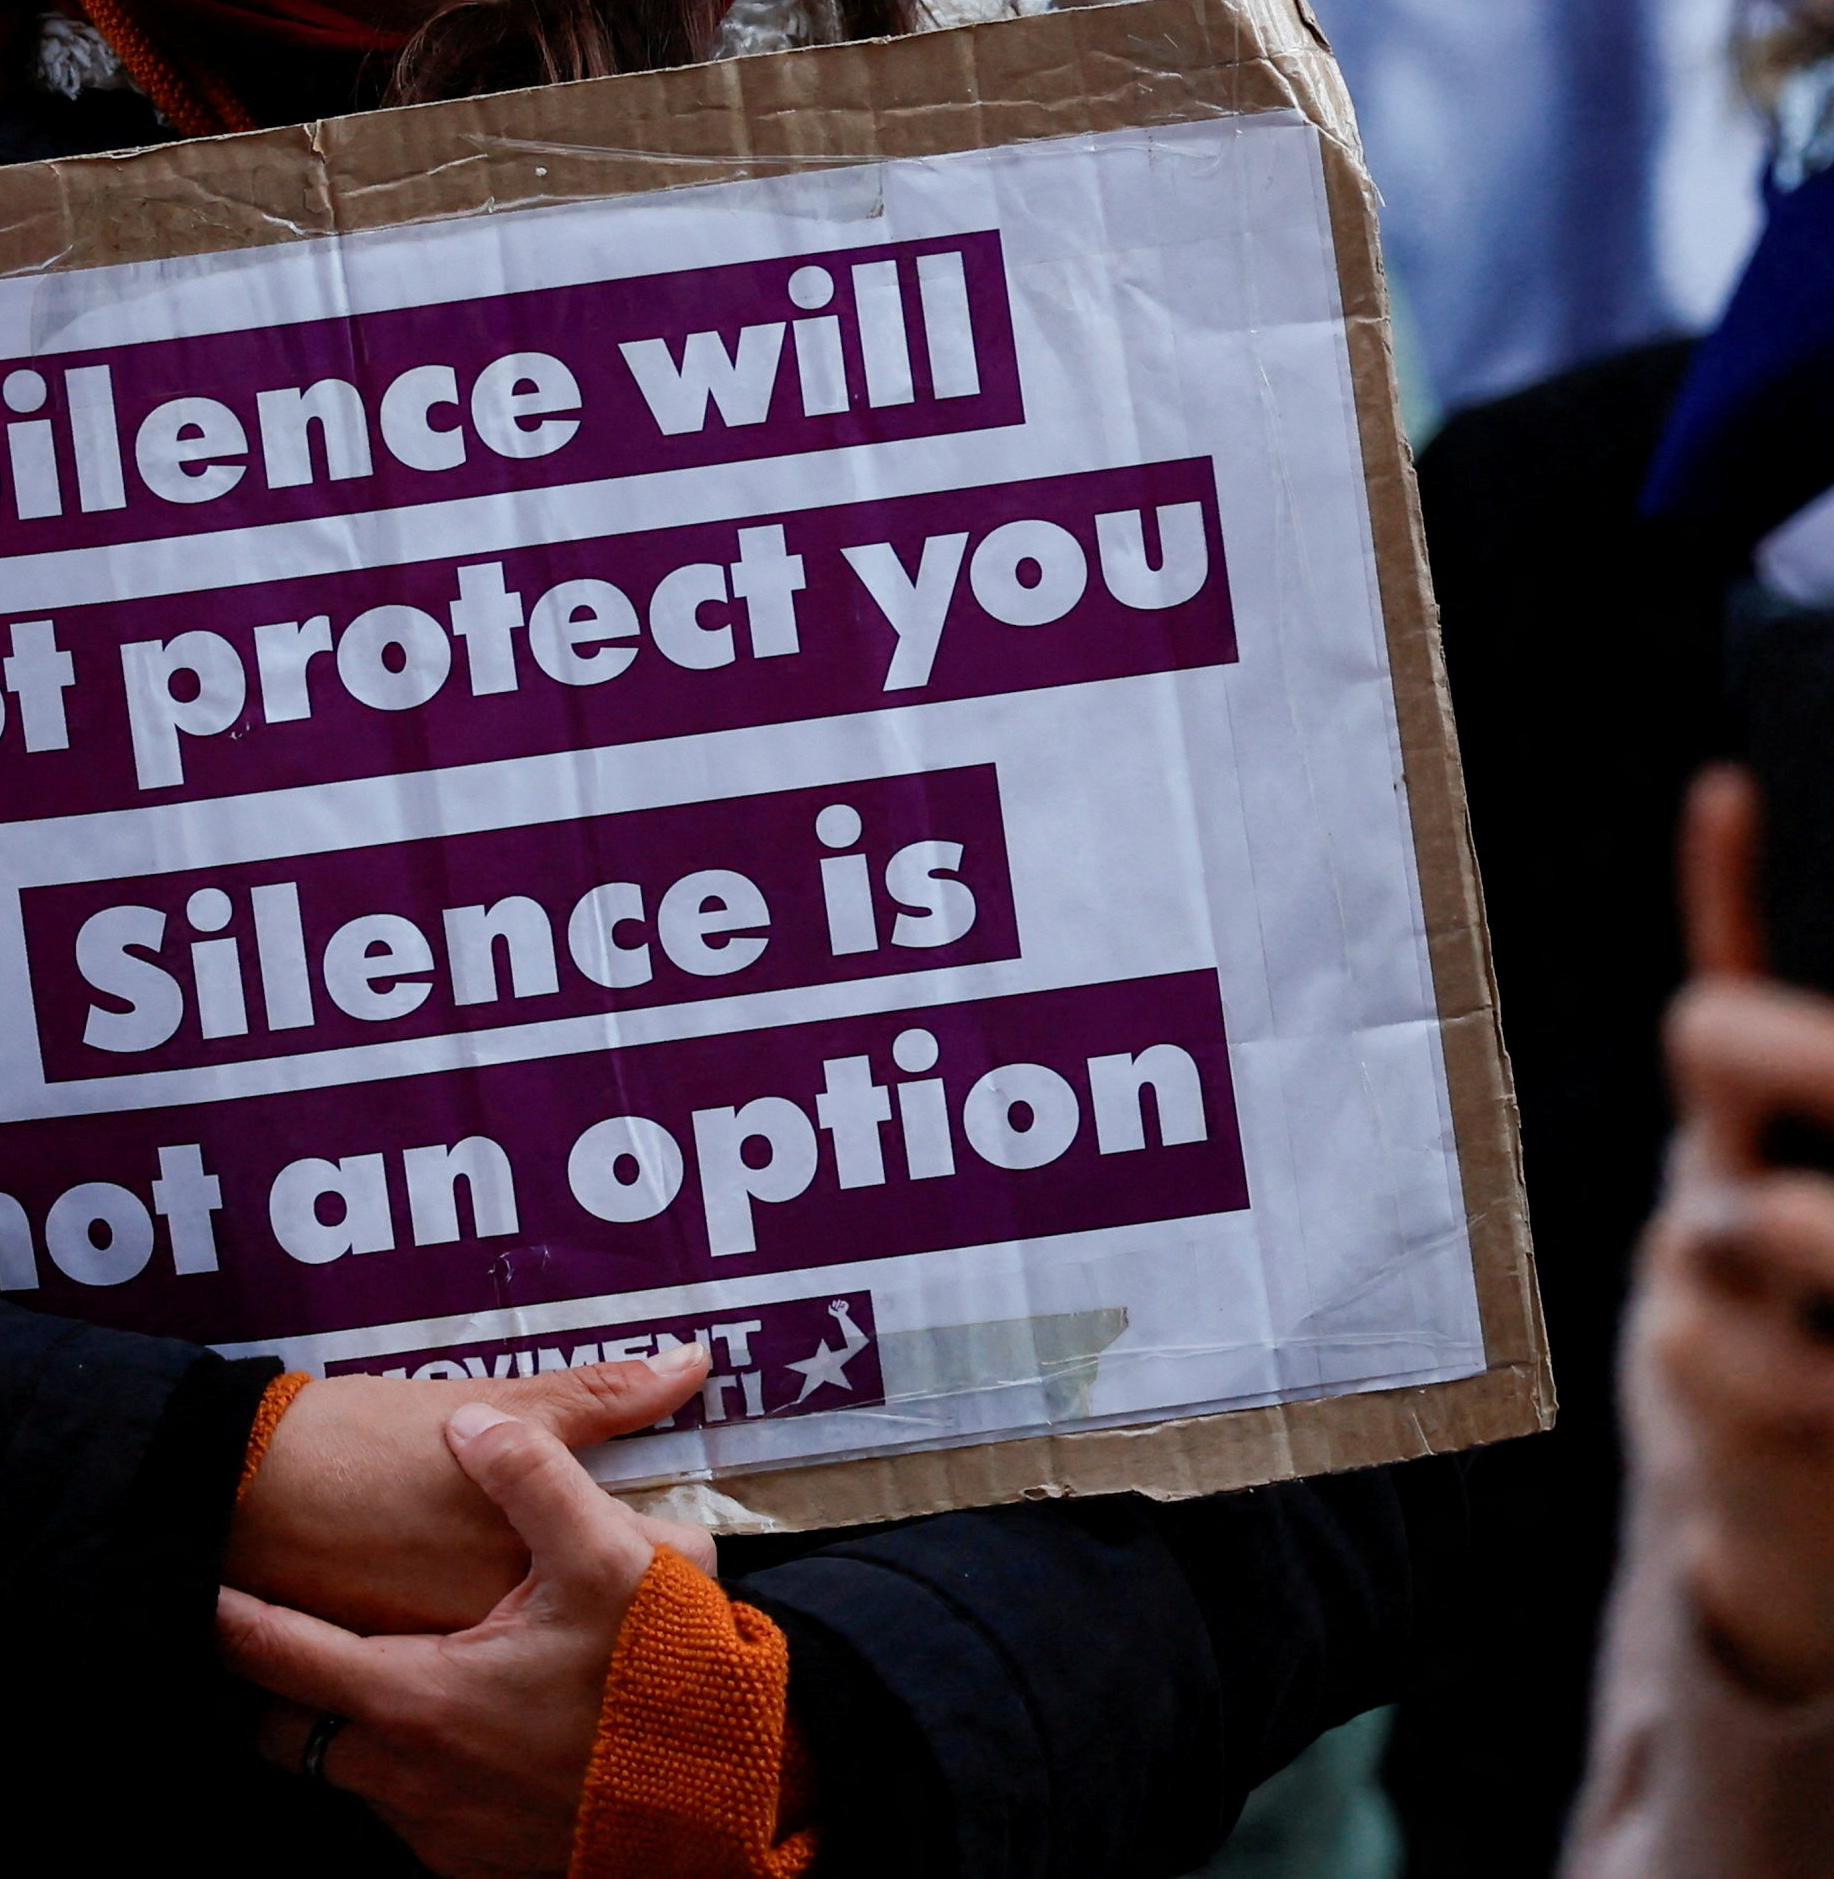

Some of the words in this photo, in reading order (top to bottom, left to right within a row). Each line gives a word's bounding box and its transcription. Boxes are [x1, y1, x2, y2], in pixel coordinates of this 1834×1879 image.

[618, 250, 981, 436] will
[119, 523, 807, 792] protect
[840, 501, 1209, 692] you
[75, 869, 771, 1053] Silence
[815, 804, 977, 956] is
[269, 1135, 520, 1265] an
[567, 1028, 1208, 1258] option
